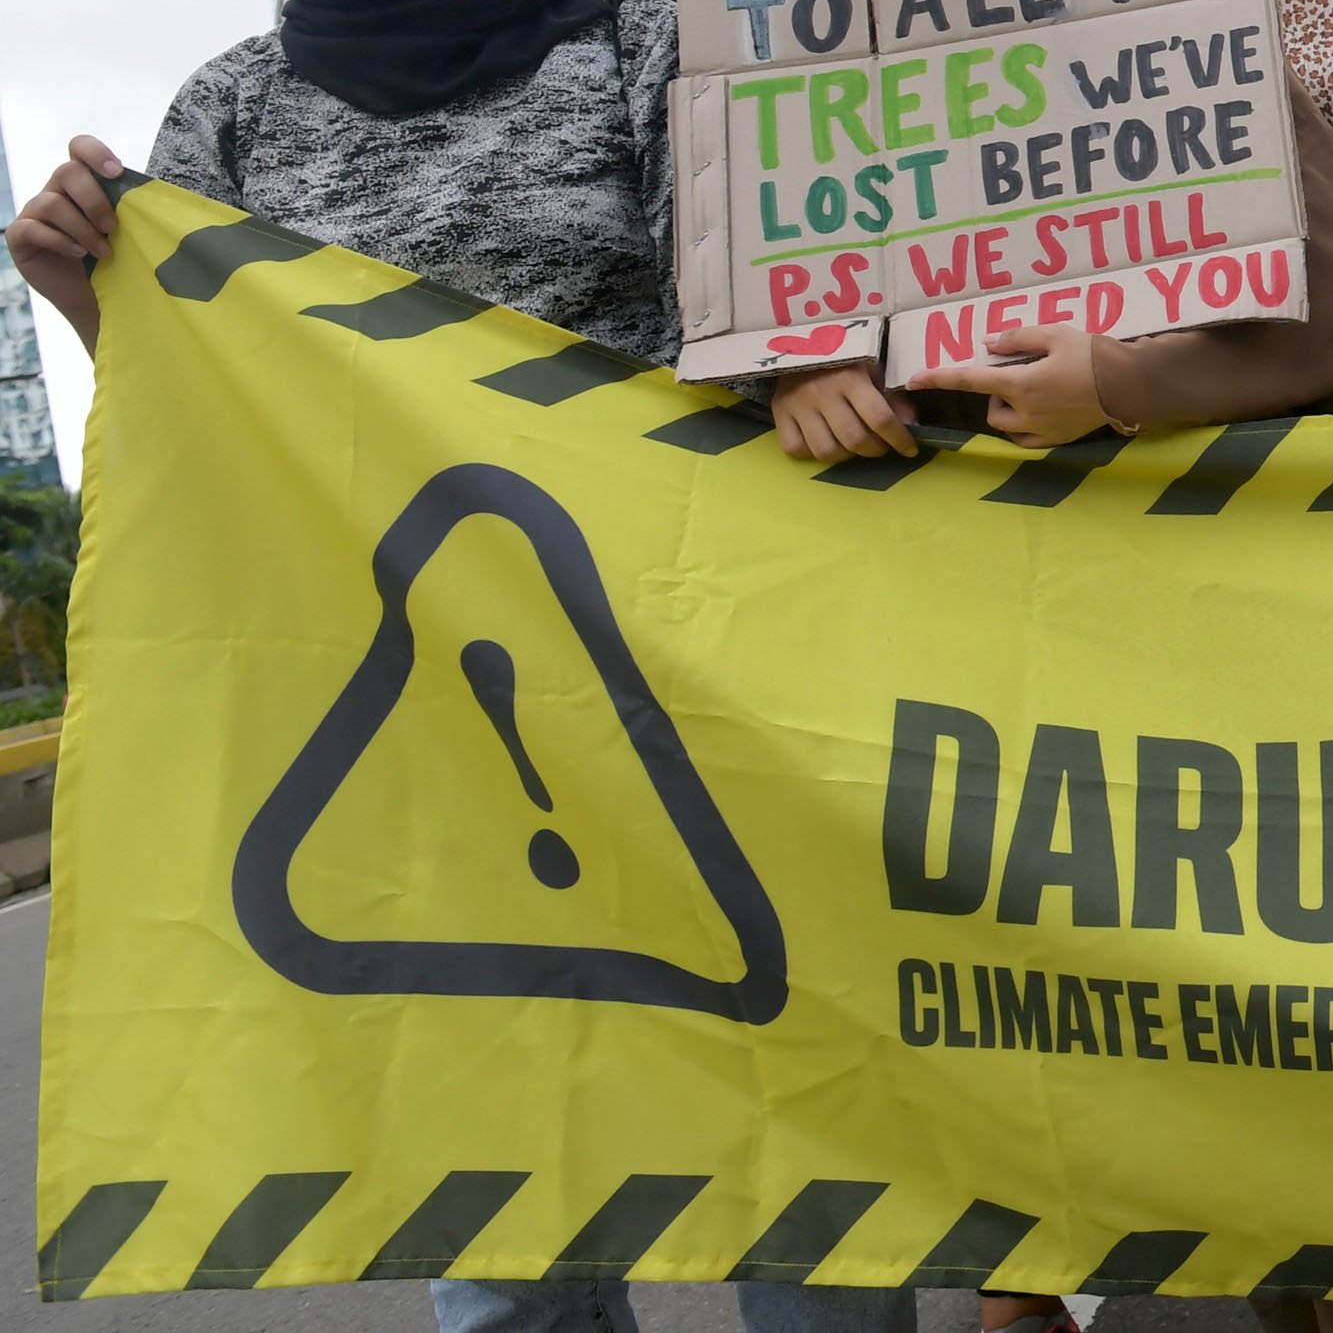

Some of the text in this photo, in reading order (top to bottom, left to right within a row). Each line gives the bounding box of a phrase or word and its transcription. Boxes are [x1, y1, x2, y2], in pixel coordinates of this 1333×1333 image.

[730, 25, 1264, 170] TREES WE'VE
[759, 100, 1254, 242] LOST BEFORE
[768, 192, 1228, 326] P.S. WE STILL
[924, 249, 1290, 370] NEED YOU
[897, 958, 1169, 1061] CLIMATE
